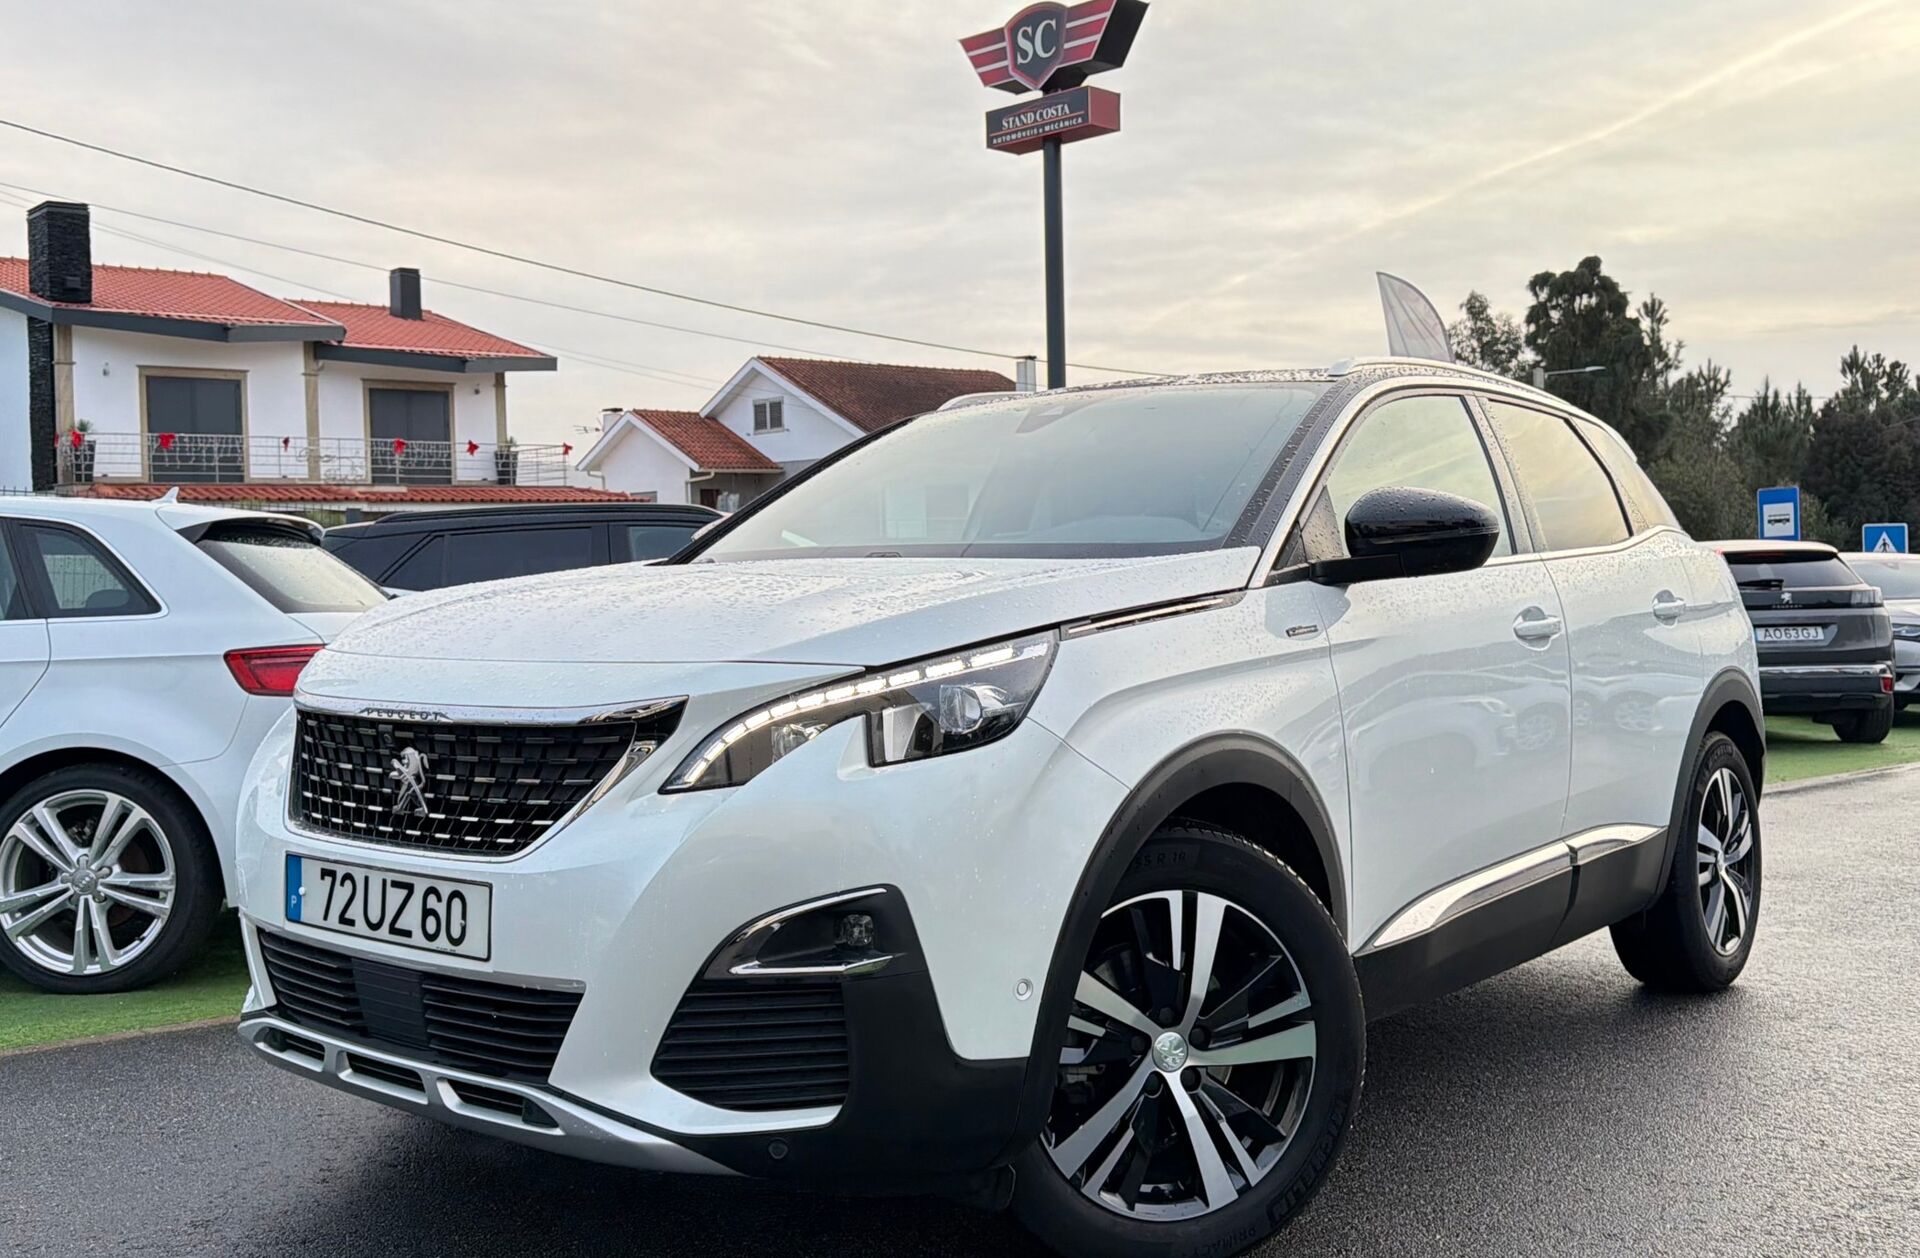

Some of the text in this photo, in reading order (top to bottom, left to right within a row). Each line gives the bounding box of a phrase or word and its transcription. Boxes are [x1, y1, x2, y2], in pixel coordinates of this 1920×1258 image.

[1017, 18, 1057, 65] SC
[1002, 104, 1070, 131] STAND COSTA
[1764, 627, 1819, 640] AO63GJ
[366, 708, 440, 721] PEUGEOT
[291, 868, 467, 947] P 72UZ60
